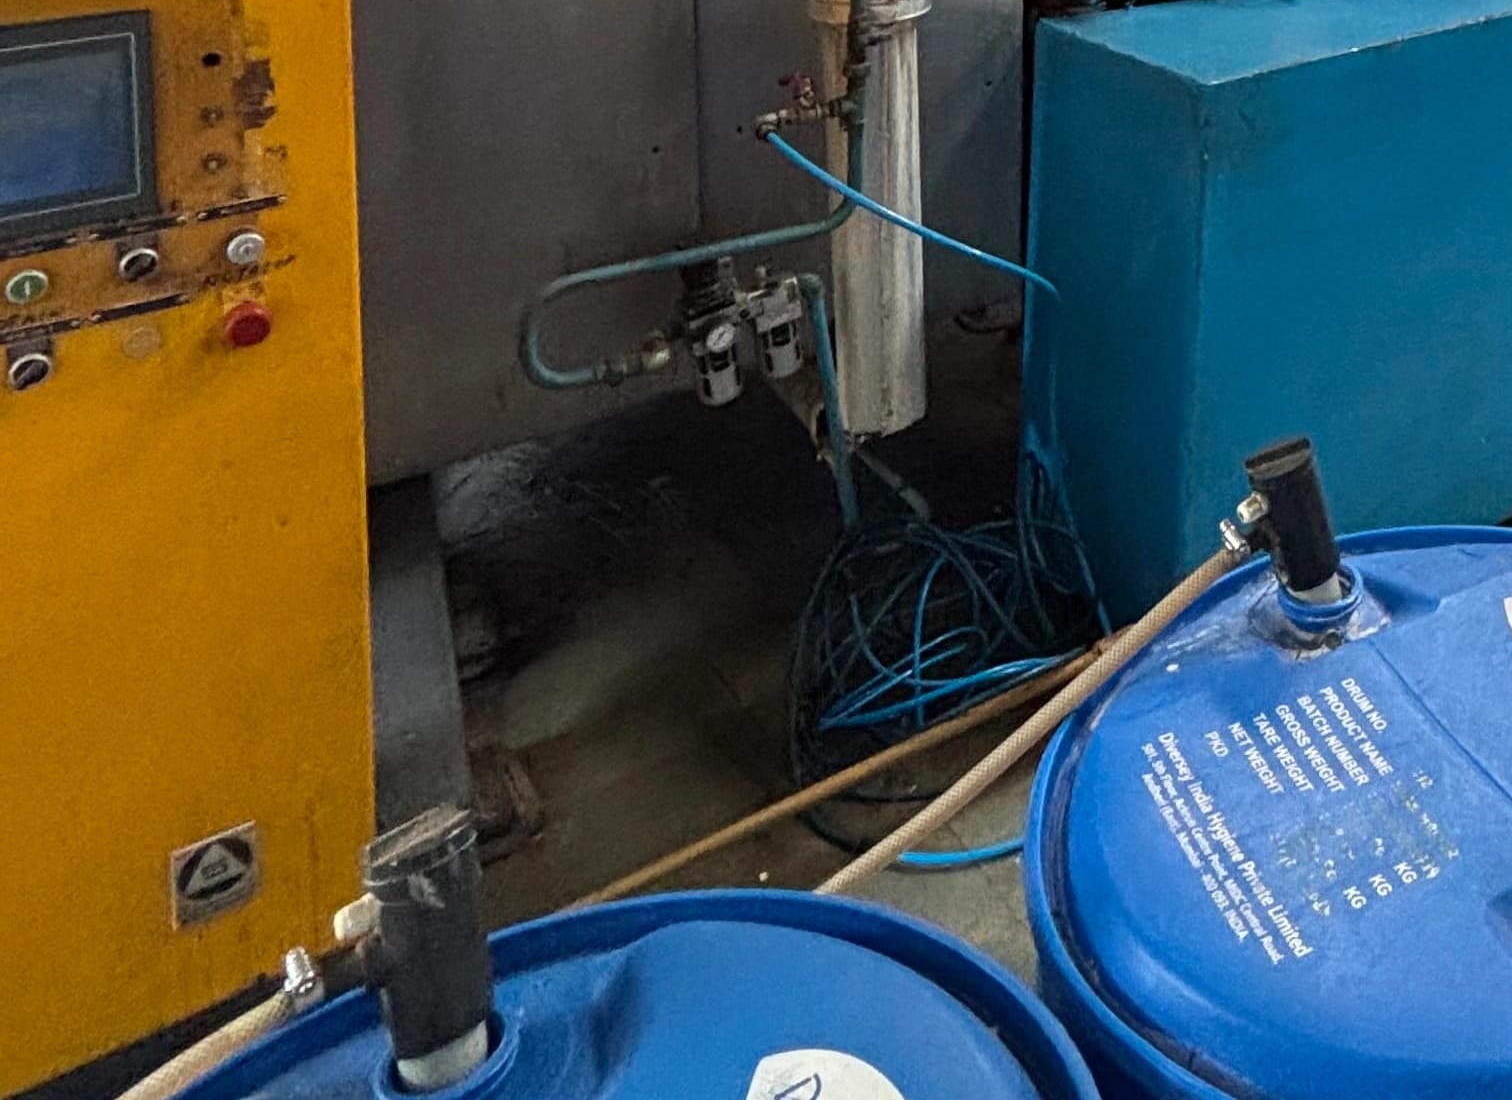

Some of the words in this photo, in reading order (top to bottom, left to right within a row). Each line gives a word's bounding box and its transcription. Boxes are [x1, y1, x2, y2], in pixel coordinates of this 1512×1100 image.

[1297, 696, 1332, 735] BATCH
[1325, 736, 1369, 785] NUMBER
[1320, 687, 1367, 741] PRODUCT
[1359, 741, 1393, 775] NAME
[1342, 678, 1373, 712] DRUM
[1367, 710, 1388, 733] NO.
[1206, 731, 1228, 756] PKD
[1228, 723, 1254, 746] NET
[1245, 747, 1283, 793] WEIGHT
[1254, 713, 1282, 746] TARE
[1274, 745, 1313, 791] WEIGHT
[1276, 705, 1311, 747] GROSS
[1304, 746, 1344, 792] WEIGHT
[1159, 733, 1194, 781] Diversey
[1188, 782, 1213, 813] India
[1207, 812, 1244, 861] Hygiene
[1239, 861, 1274, 906] Private
[1268, 905, 1312, 957] Limited
[1394, 862, 1417, 883] KG
[1344, 887, 1366, 908] KG
[1370, 874, 1392, 896] KG
